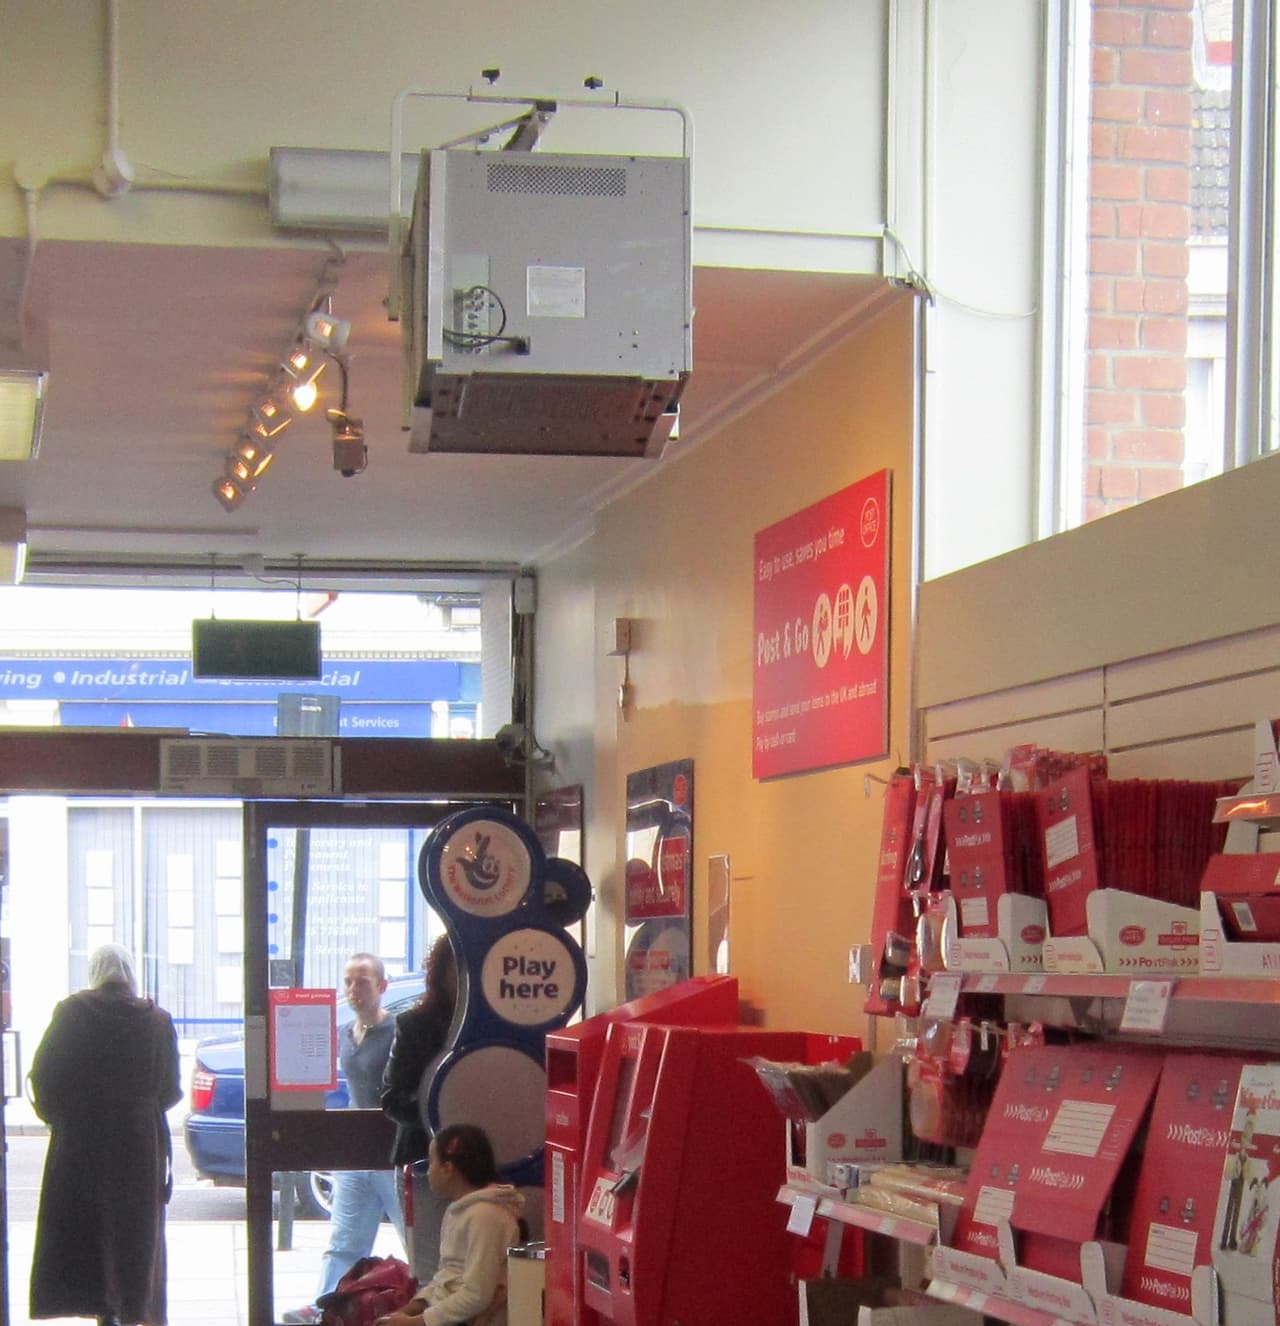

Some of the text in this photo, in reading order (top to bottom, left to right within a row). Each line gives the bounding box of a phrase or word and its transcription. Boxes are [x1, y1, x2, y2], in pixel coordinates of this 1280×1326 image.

[757, 617, 809, 666] Post & Go
[71, 669, 187, 687] Industrial
[351, 715, 400, 730] Services
[502, 956, 556, 981] Play
[499, 978, 559, 999] here
